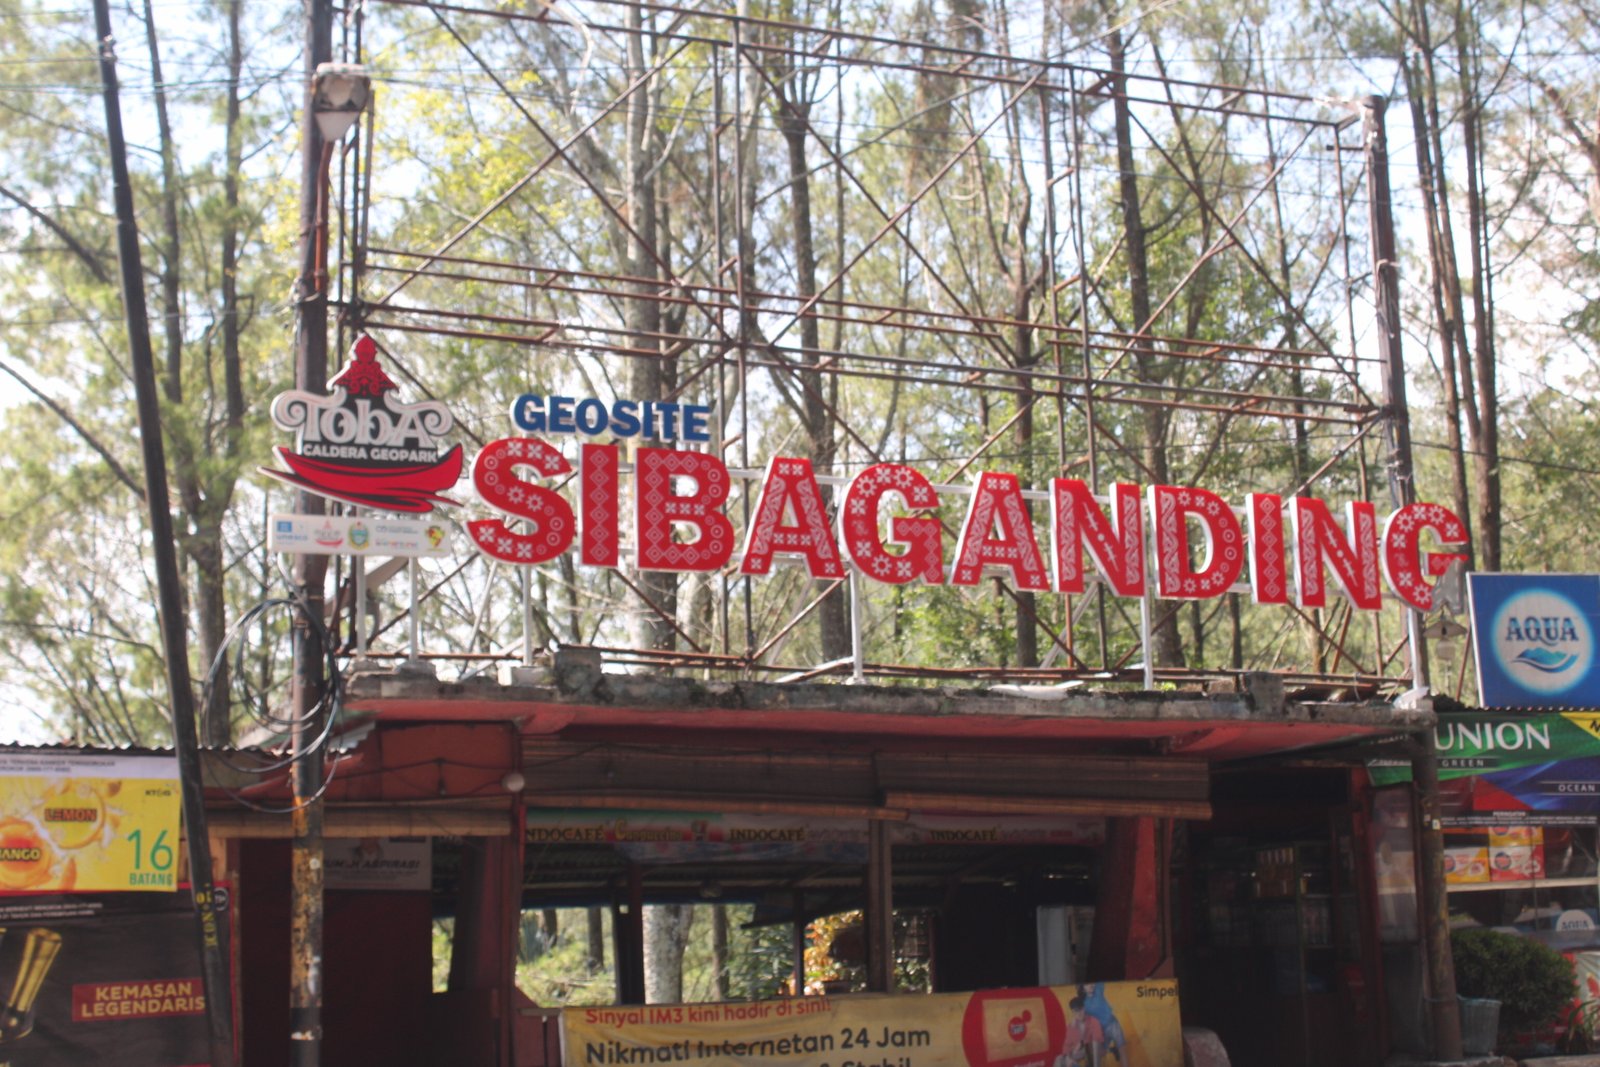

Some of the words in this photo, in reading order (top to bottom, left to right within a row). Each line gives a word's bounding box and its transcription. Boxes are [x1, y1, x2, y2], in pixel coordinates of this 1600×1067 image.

[510, 394, 713, 442] GEOSITE
[303, 444, 367, 460] CALDERA
[370, 449, 438, 463] GEOPARK
[466, 437, 1469, 612] SIBAGANDING
[1505, 616, 1579, 647] AQUA
[1434, 721, 1550, 751] UNION
[1442, 759, 1484, 768] GREEN
[1558, 783, 1596, 793] OCEAN
[45, 808, 98, 822] LEMON
[525, 826, 604, 842] NDOCAFÉ
[127, 828, 173, 872] 16
[129, 873, 173, 887] BATANG
[95, 982, 192, 1001] KEMASAN
[1136, 984, 1179, 1001] Simpel
[81, 996, 206, 1018] LEGENDARIS
[585, 1007, 644, 1029] Sinyal
[650, 1008, 683, 1025] IM3
[689, 1005, 721, 1023] kini
[724, 1000, 772, 1022] hadir
[776, 998, 792, 1017] di
[585, 1039, 690, 1065] Nikmati
[698, 1032, 835, 1059] Internetan
[840, 1027, 870, 1049] 24
[876, 1026, 930, 1048] Jam
